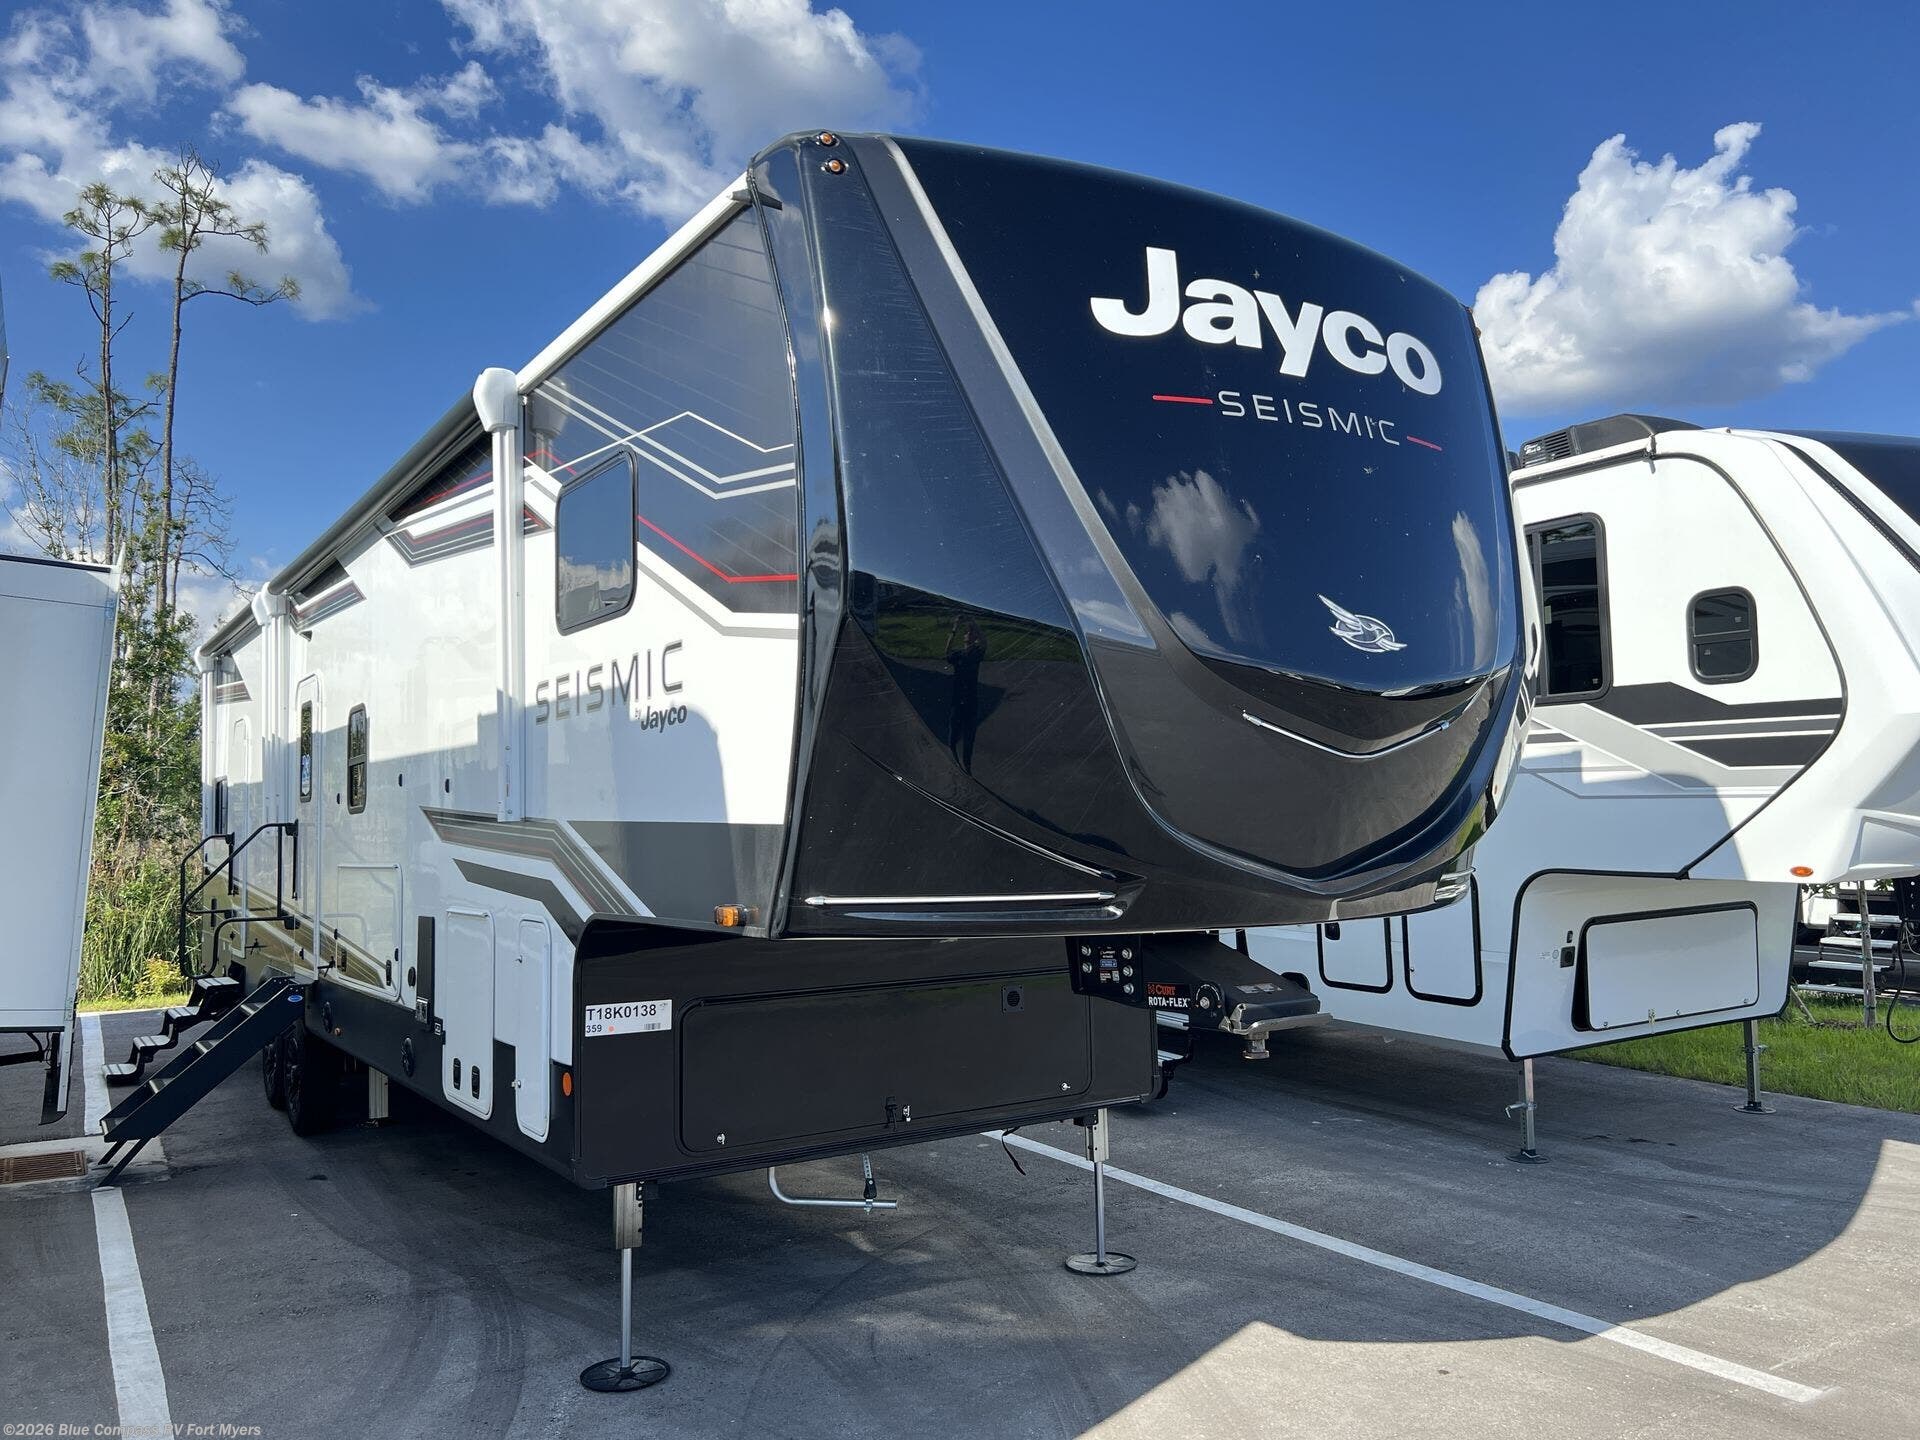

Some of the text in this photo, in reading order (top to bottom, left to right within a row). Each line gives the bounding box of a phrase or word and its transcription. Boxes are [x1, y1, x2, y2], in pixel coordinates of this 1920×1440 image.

[1090, 246, 1442, 396] Jayco
[1217, 390, 1400, 446] SEISMIC
[535, 639, 683, 726] SEISMIC
[640, 704, 688, 734] Jayco
[586, 1004, 657, 1021] T18K0138
[586, 1024, 603, 1033] 359
